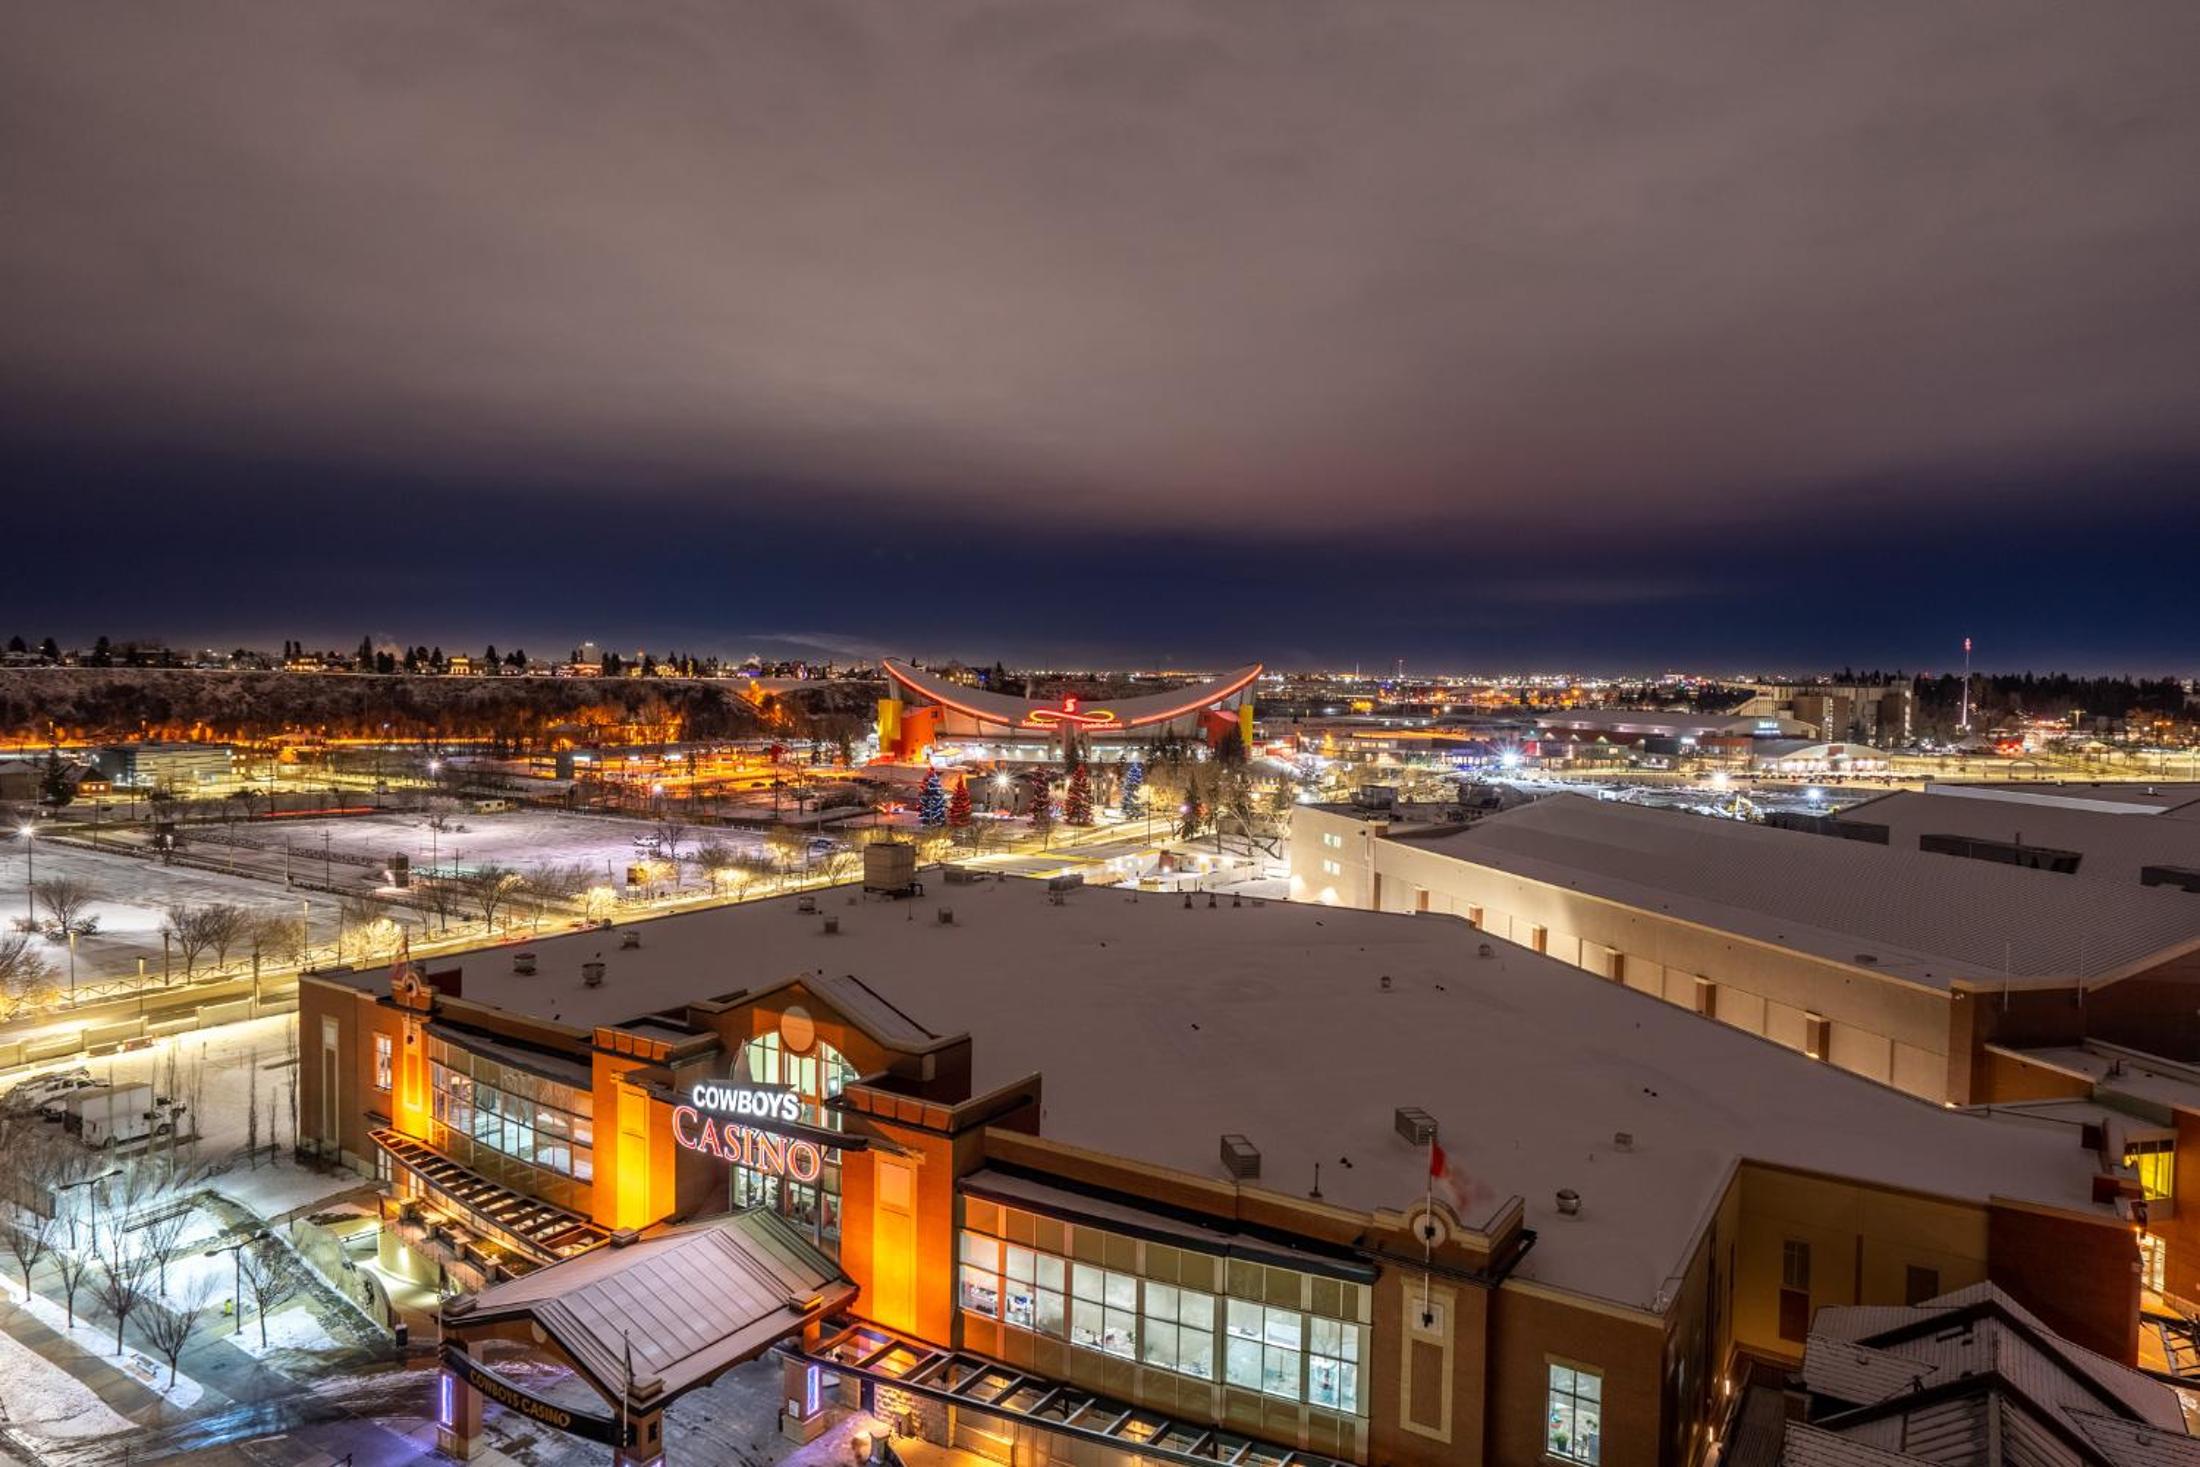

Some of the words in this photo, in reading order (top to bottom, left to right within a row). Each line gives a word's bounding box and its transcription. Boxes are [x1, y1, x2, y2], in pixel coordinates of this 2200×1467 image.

[692, 1084, 801, 1121] COWBOYS
[672, 1105, 821, 1182] CASINO
[470, 1369, 520, 1408] COWBOYS
[521, 1398, 571, 1427] CASINO
